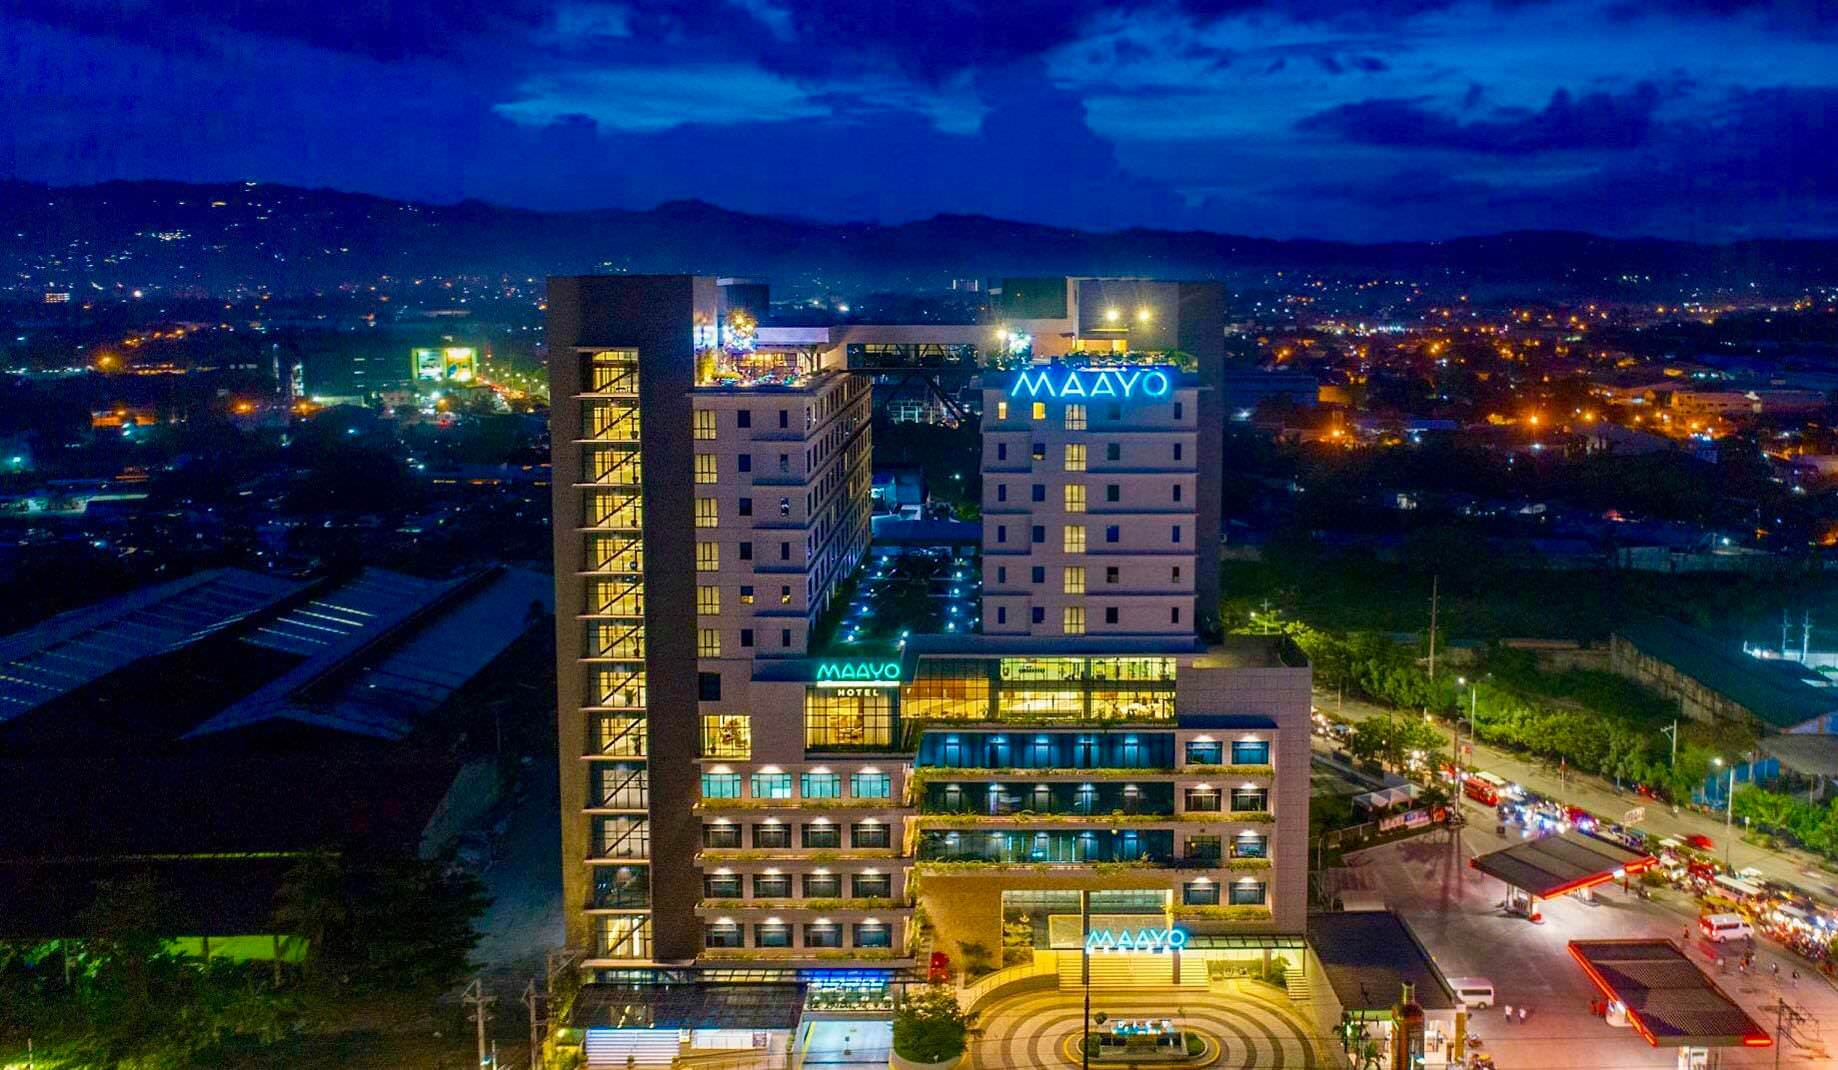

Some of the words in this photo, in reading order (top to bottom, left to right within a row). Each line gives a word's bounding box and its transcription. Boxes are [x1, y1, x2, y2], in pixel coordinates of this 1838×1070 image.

[1011, 371, 1168, 397] MAAYO
[816, 662, 900, 679] MAAYO
[837, 688, 879, 697] HOTEL
[1086, 929, 1185, 947] MAAYO
